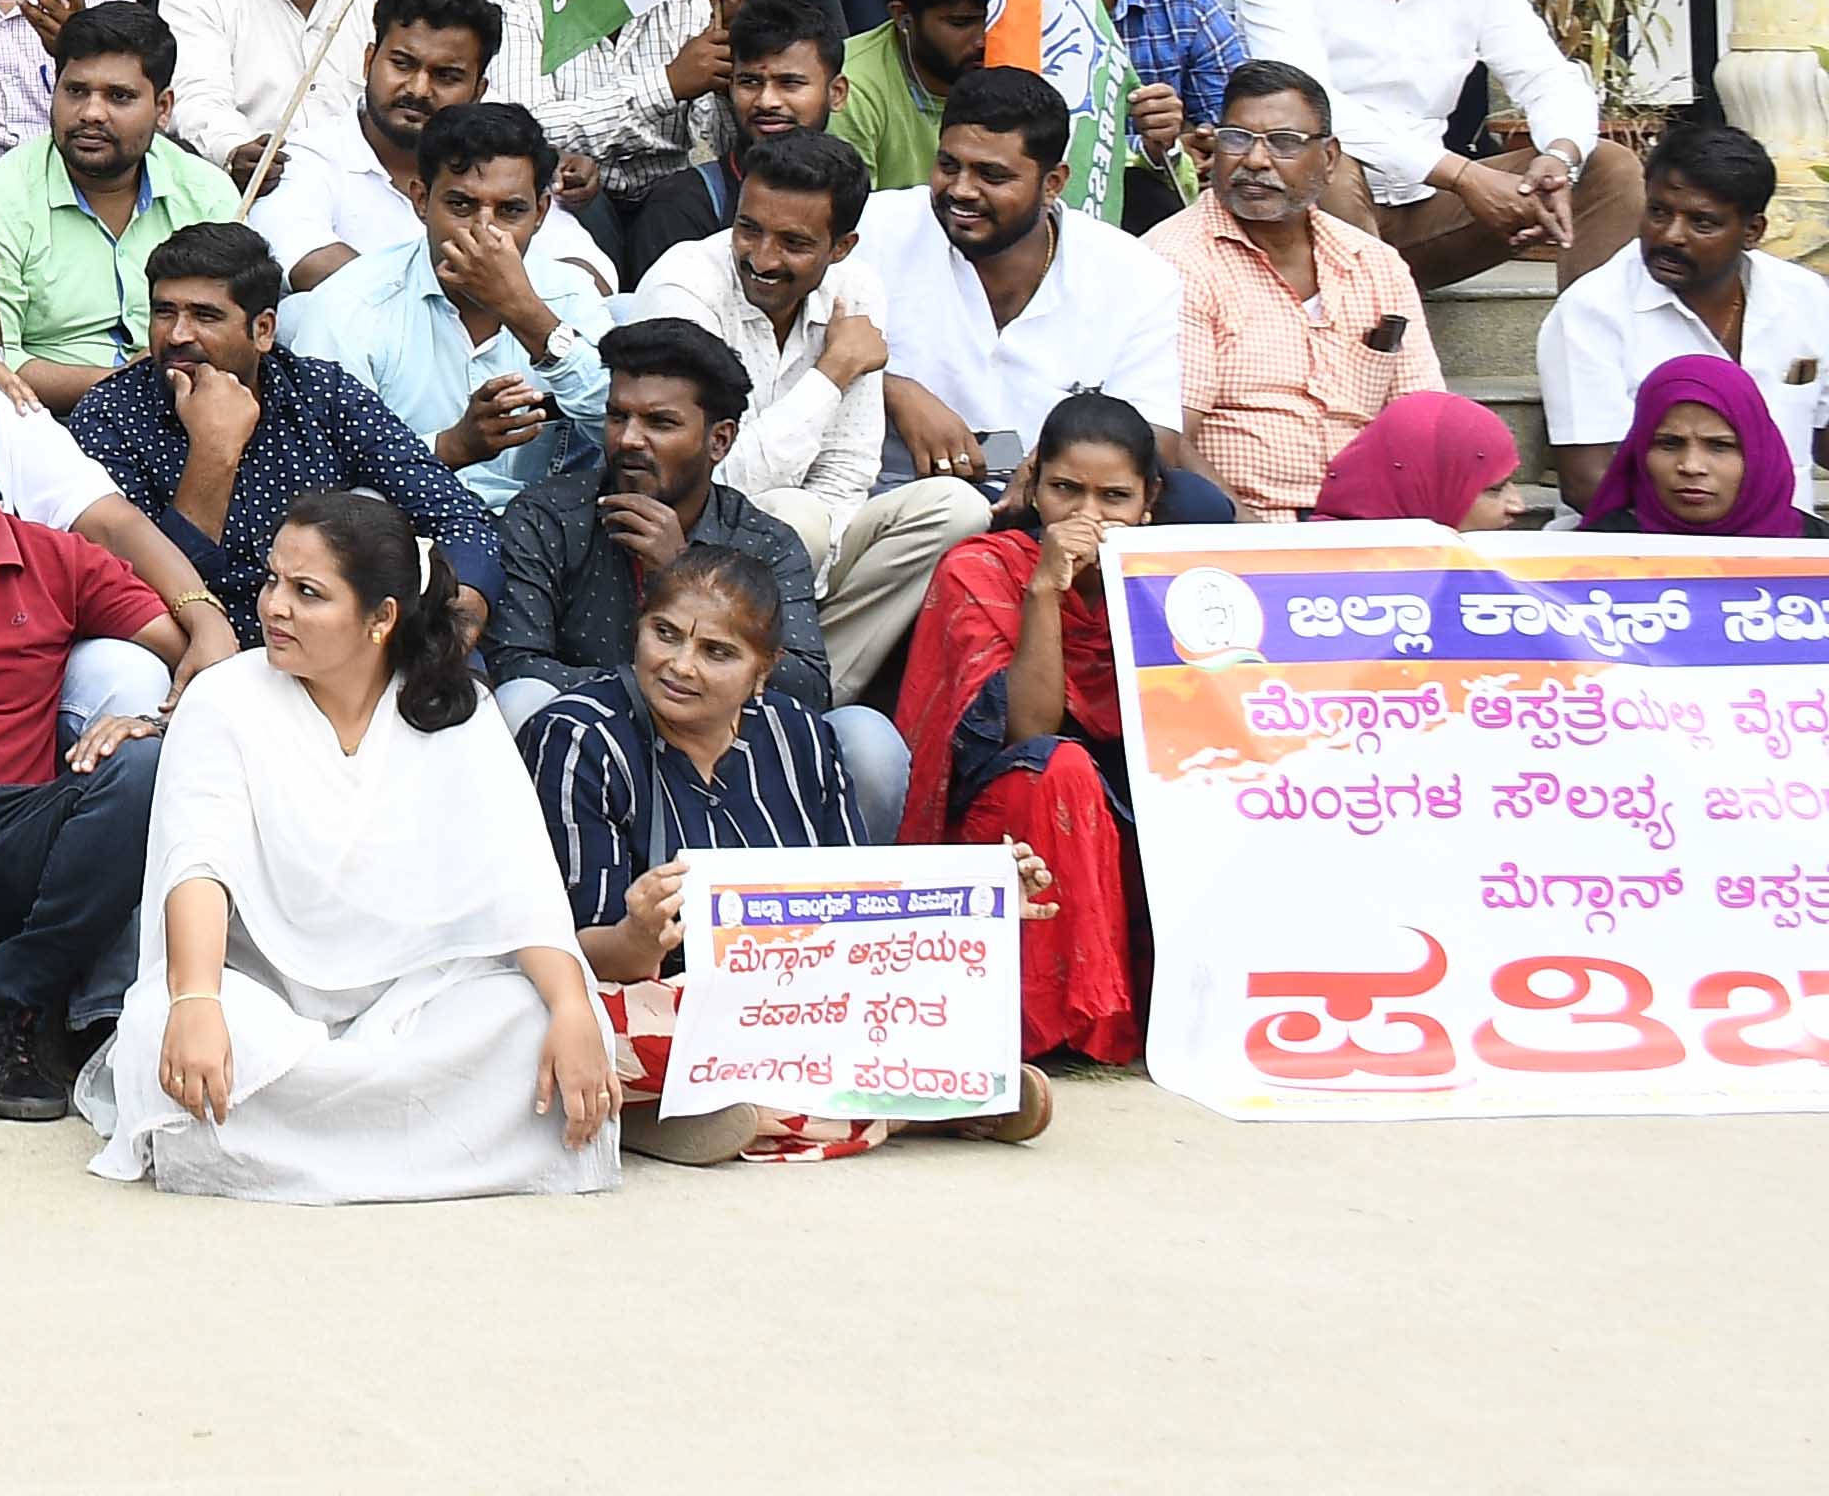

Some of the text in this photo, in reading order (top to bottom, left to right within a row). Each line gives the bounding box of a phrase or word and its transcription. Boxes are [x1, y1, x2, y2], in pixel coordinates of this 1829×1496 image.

[1285, 586, 1829, 658] ಜಿಲ್ಲಾ ಕಾಂಗ್ರೆಸ್ ಸಮಿ
[1247, 683, 1442, 754] ಮೆಗ್ಗಾನ್
[1470, 681, 1715, 751] ಆಸ್ಪತ್ರೆಯಲ್ಲಿ
[1236, 772, 1463, 836] ಯಂತ್ರಗಳ
[1492, 772, 1675, 850] ಸೌಲಭ್ಯ
[747, 898, 783, 923] ಜಿಲ್ಲಾ
[788, 893, 853, 923] ಕಾಂಗ್ರೆಸ್
[907, 890, 965, 918] ಶಿವಮೊಗ್ಗ
[1480, 862, 1684, 934] ಮೆಗ್ಗಾನ್
[729, 930, 987, 987] ಮೆಗ್ಗಾನ್ ಆಸ್ಪತ್ರೆಯಲ್ಲಿ
[739, 992, 948, 1047] ತಪಾಸಣೆ ಸ್ಥಗಿತ
[688, 1055, 989, 1096] ರೋಗಿಗಳ ಪರದಾಟ
